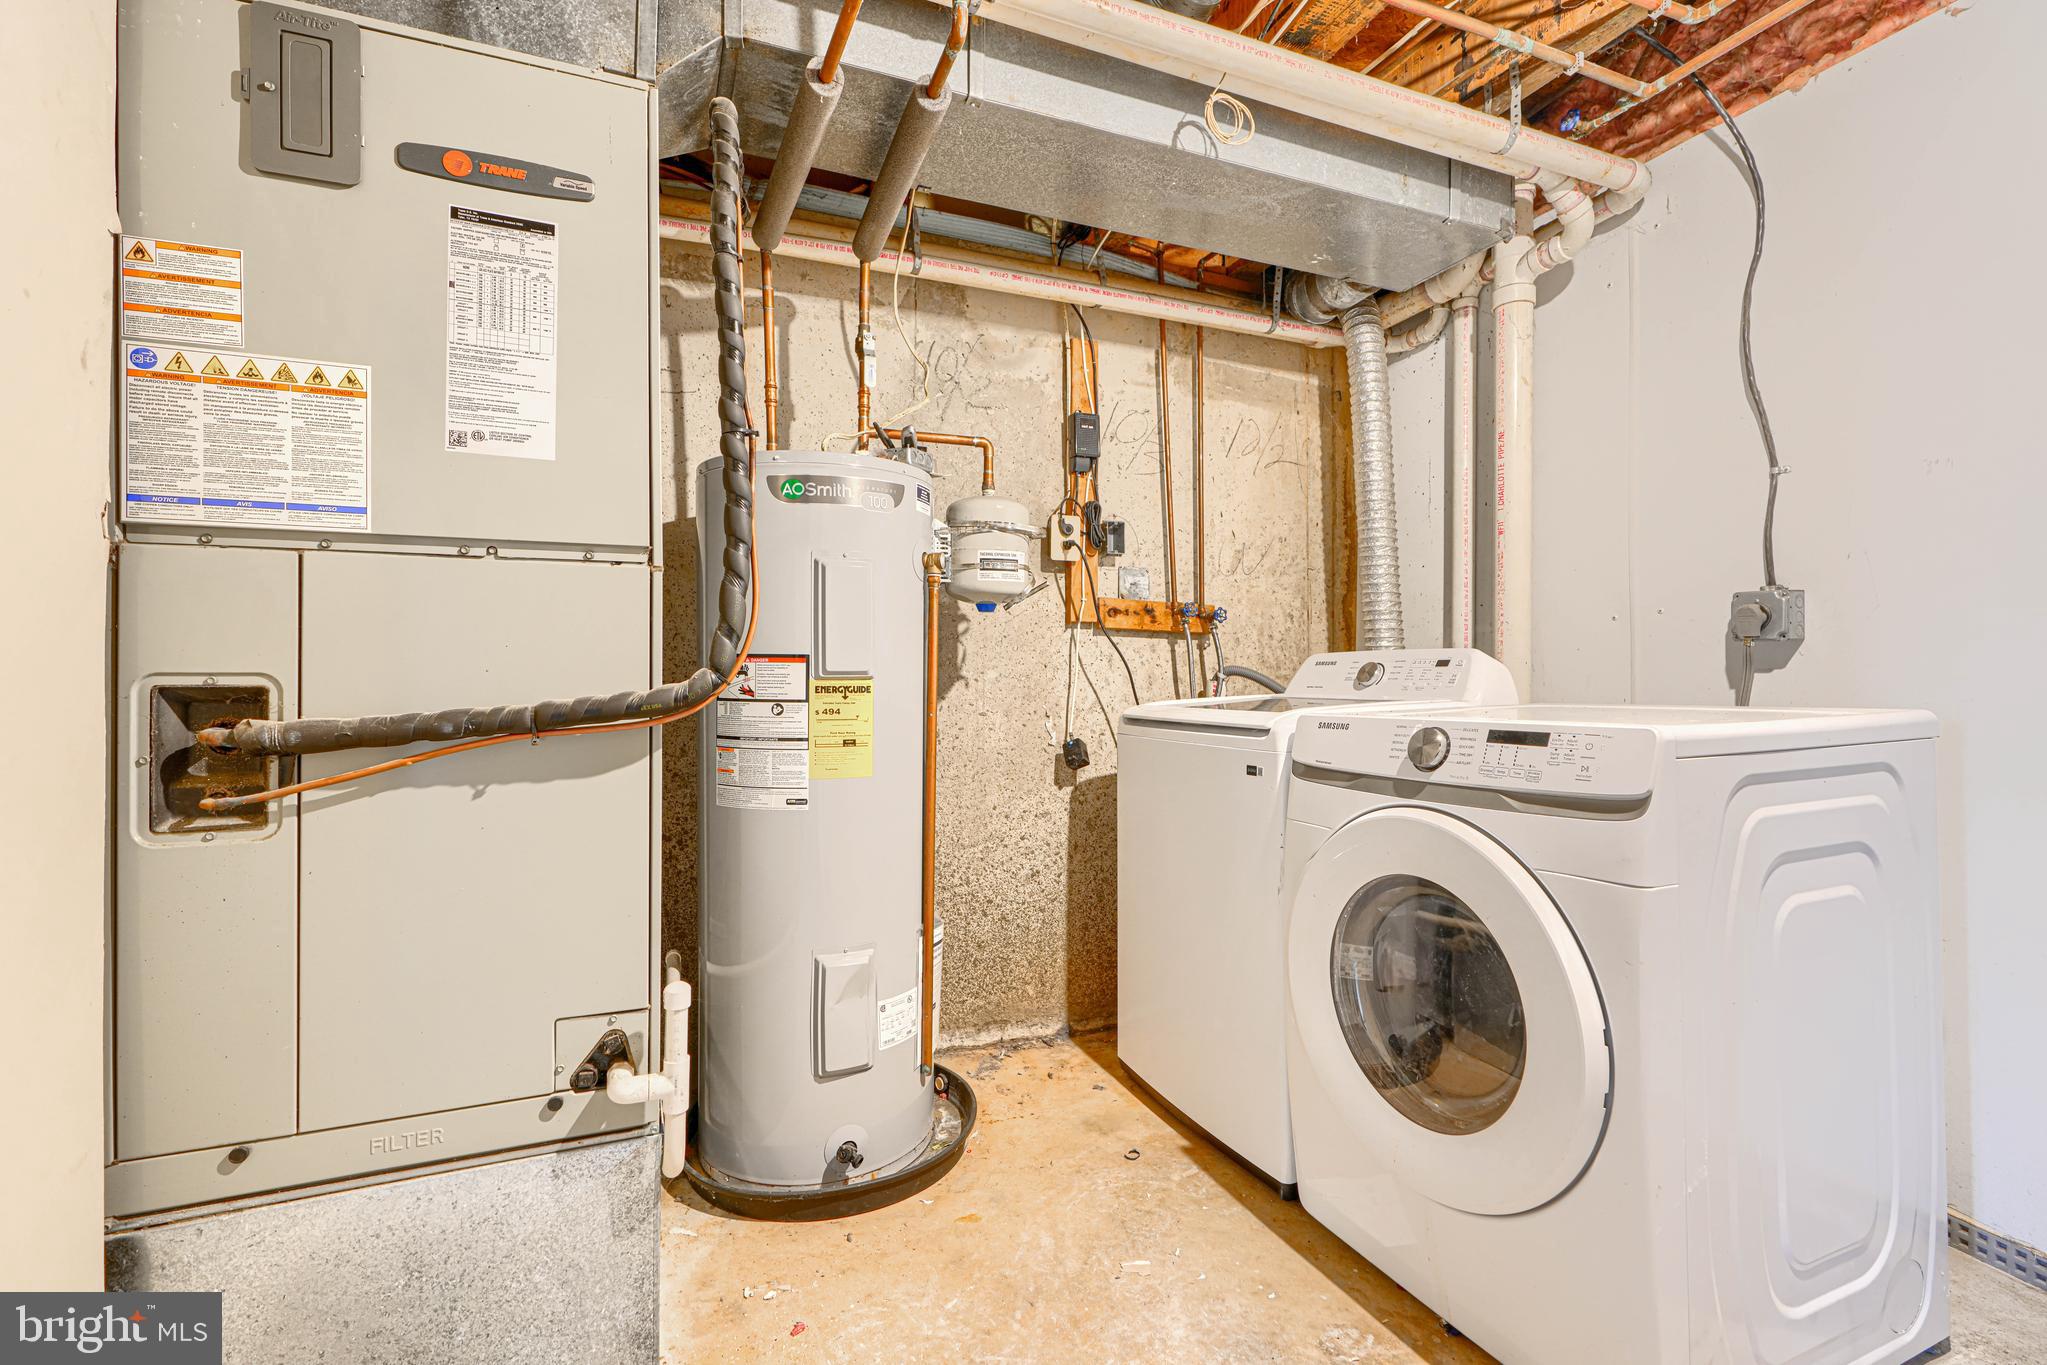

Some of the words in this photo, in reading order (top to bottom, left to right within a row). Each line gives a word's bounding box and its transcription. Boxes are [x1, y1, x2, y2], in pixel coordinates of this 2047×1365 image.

[479, 161, 528, 180] TRANE
[185, 246, 218, 255] WARNING
[157, 273, 215, 285] AVERTISSEMENT
[162, 307, 212, 318] ADVERTENCIA
[152, 372, 185, 380] WARNING
[223, 379, 277, 389] AVERTISSEMENT
[310, 387, 354, 396] ADVERTENCIA
[868, 495, 889, 509] 100
[1318, 722, 1350, 730] SAMSUNG
[370, 1128, 444, 1156] FILTER
